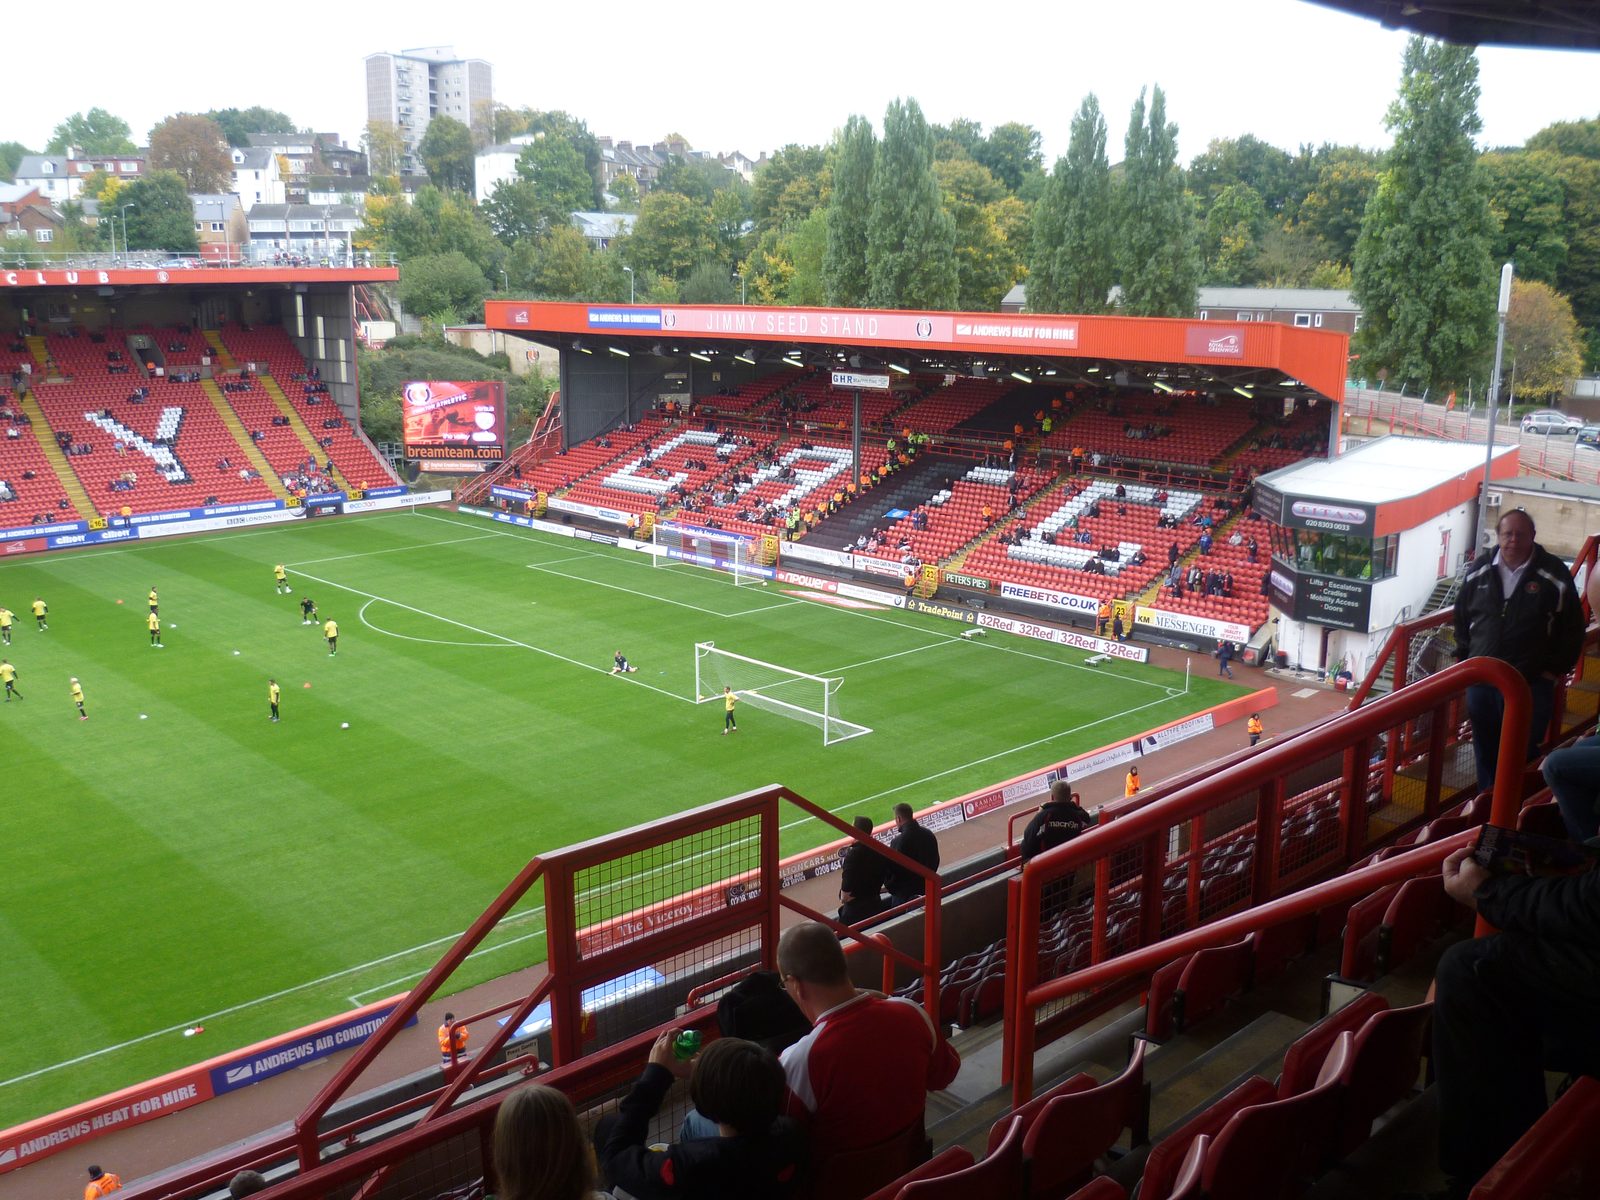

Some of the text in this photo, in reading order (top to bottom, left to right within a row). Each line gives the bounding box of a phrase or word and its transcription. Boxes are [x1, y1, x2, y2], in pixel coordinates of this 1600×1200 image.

[6, 272, 109, 285] CLUB
[706, 313, 878, 336] JIMMY SEED STAND
[972, 325, 1075, 340] ANDREWS HEAT FOR HIRE
[407, 446, 502, 459] breamteam.com
[1299, 505, 1360, 520] TITAN
[1306, 519, 1318, 527] 020
[784, 572, 829, 591] npower
[946, 574, 987, 589] PETER'S PIES
[1309, 578, 1362, 592] Lifts Escalators
[1002, 585, 1097, 611] FREEBETS.CO.UK
[1323, 588, 1348, 598] Cradles
[1310, 594, 1359, 608] Mobility Access
[1324, 603, 1344, 612] Doors
[918, 602, 964, 621] TradePoint
[1116, 607, 1125, 616] 23
[1138, 615, 1150, 624] KM
[1155, 616, 1216, 637] MESSENGER
[979, 614, 1142, 660] 32Red 32Red 32Red 32Red
[974, 792, 1002, 808] RAMADA
[617, 922, 644, 938] The
[646, 903, 694, 926] Viceroy
[255, 1042, 315, 1075] ANDREWS
[315, 1033, 335, 1052] AIR
[20, 1083, 197, 1158] ANDREWS HEAT FOR HIRE
